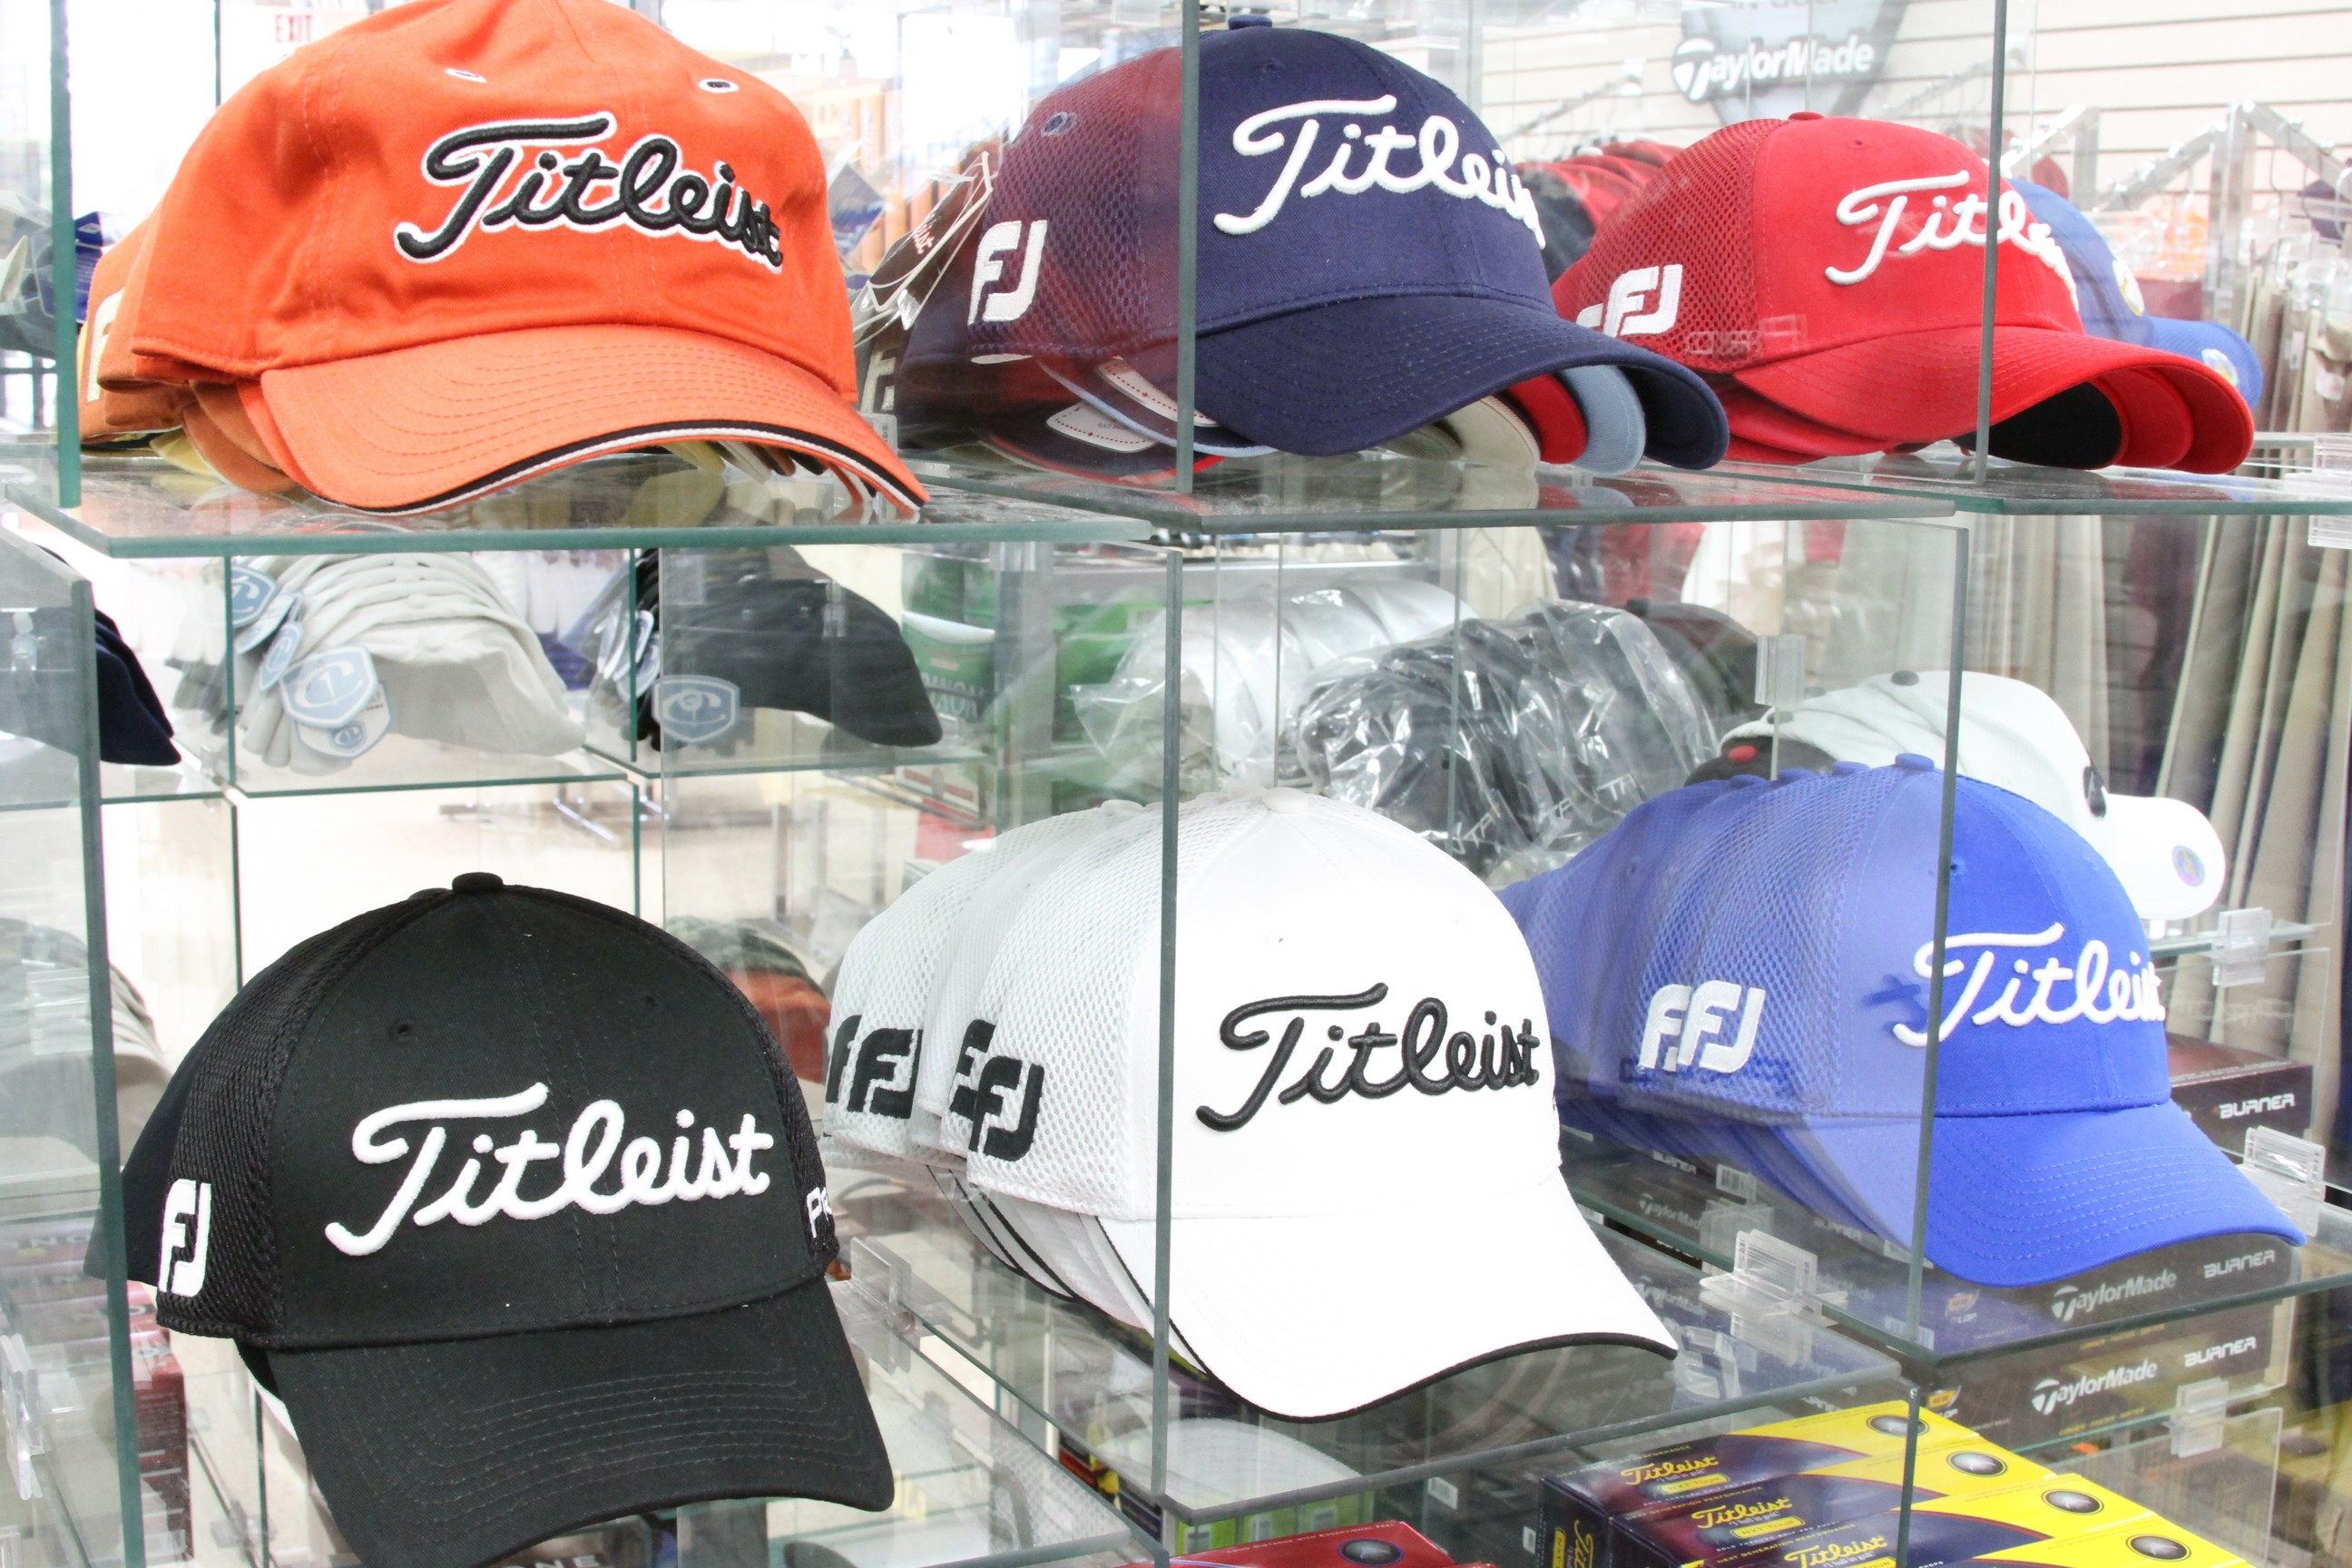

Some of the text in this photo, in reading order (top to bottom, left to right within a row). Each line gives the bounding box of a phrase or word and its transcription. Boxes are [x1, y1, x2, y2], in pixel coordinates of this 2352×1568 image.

[275, 14, 312, 43] EXIT
[1673, 37, 1874, 102] TaylorMade
[394, 111, 783, 273] Titleist
[1213, 93, 1546, 250] Titlei
[967, 219, 1047, 328] FJ
[1825, 169, 2079, 309] Titl
[1602, 263, 1683, 338] FJ
[1196, 981, 1541, 1132] Titleist
[1677, 979, 1766, 1073] FJ
[967, 1054, 1045, 1162] FJ
[2219, 1093, 2297, 1120] BURNER
[325, 1081, 774, 1257] Titleist
[158, 1180, 212, 1298] FJ
[2203, 1249, 2277, 1279] BURNER
[2051, 1269, 2178, 1323] TaylorMade
[2183, 1336, 2259, 1367] BURNER
[2031, 1358, 2158, 1416] TaylorMade
[1620, 1455, 1720, 1486] Titleist
[1690, 1496, 1793, 1530] Titleist
[1784, 1534, 1888, 1568] Titleist
